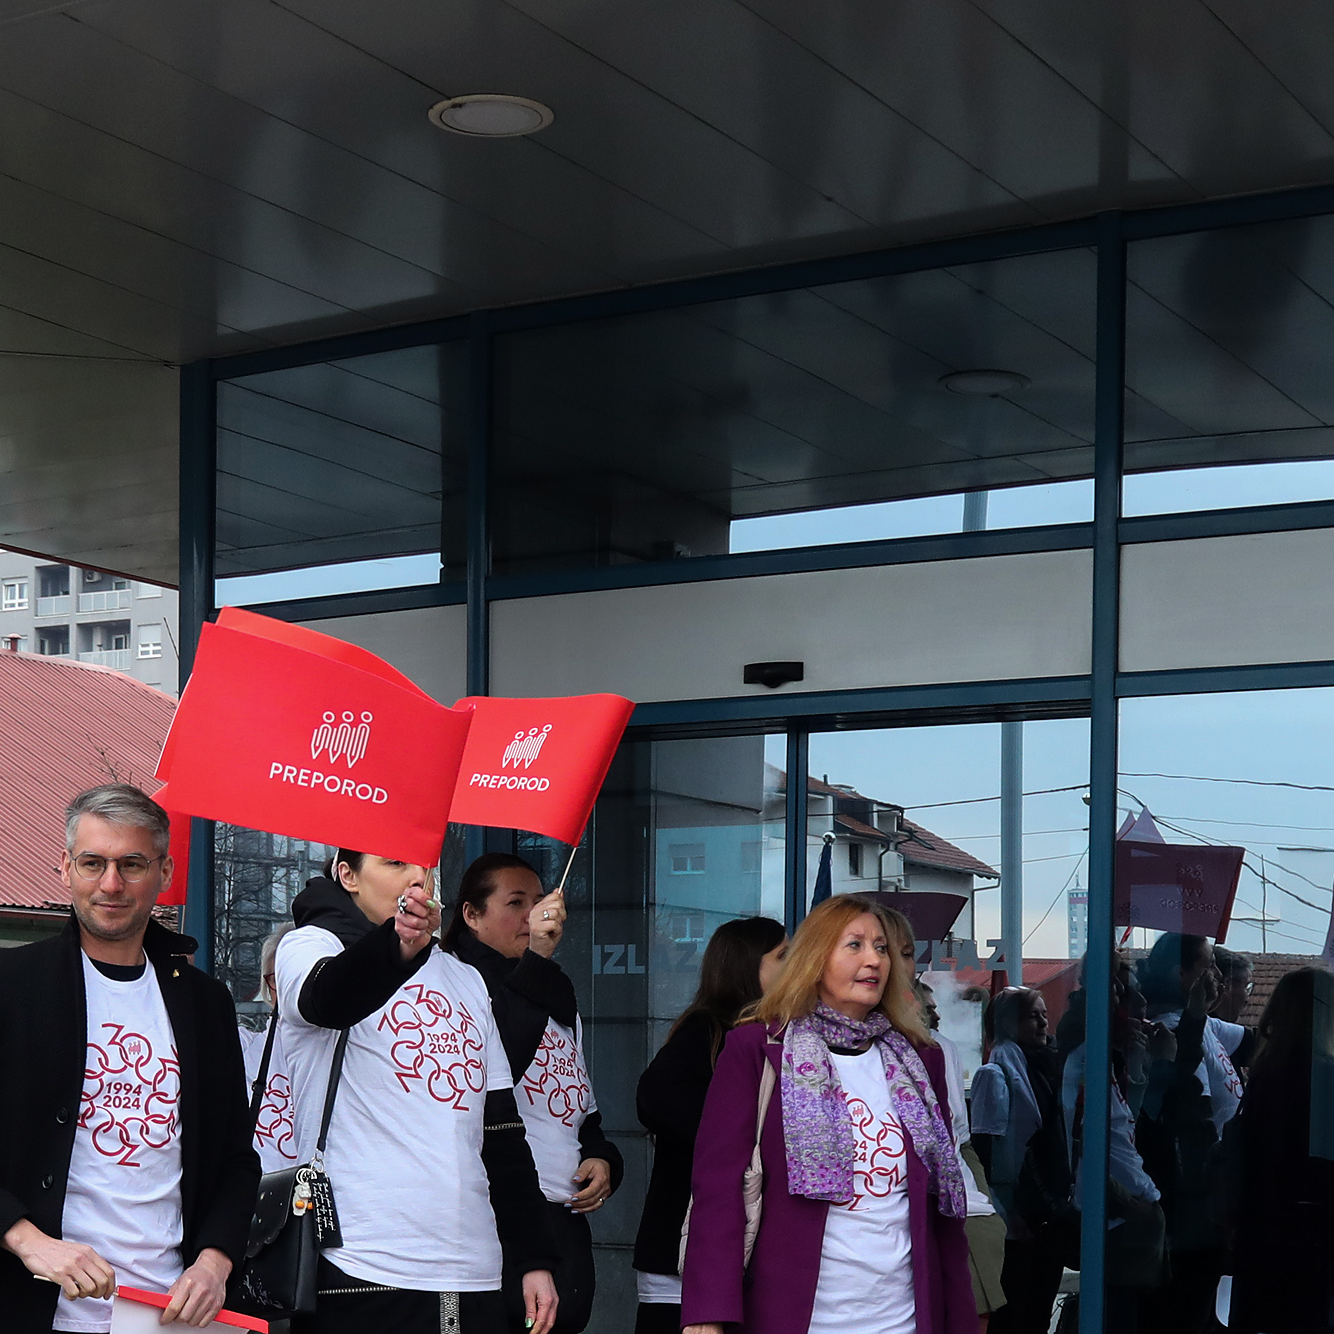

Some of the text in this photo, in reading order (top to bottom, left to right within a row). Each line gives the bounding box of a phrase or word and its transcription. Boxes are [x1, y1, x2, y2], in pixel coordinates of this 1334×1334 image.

[269, 761, 389, 805] PREPOROD
[469, 773, 549, 792] PREPOROD
[914, 940, 1008, 971] ZLAZ
[427, 1032, 457, 1043] 1994
[429, 1043, 460, 1055] 2024
[553, 1064, 575, 1079] 2024
[106, 1082, 142, 1096] 1994
[103, 1096, 141, 1110] 2024
